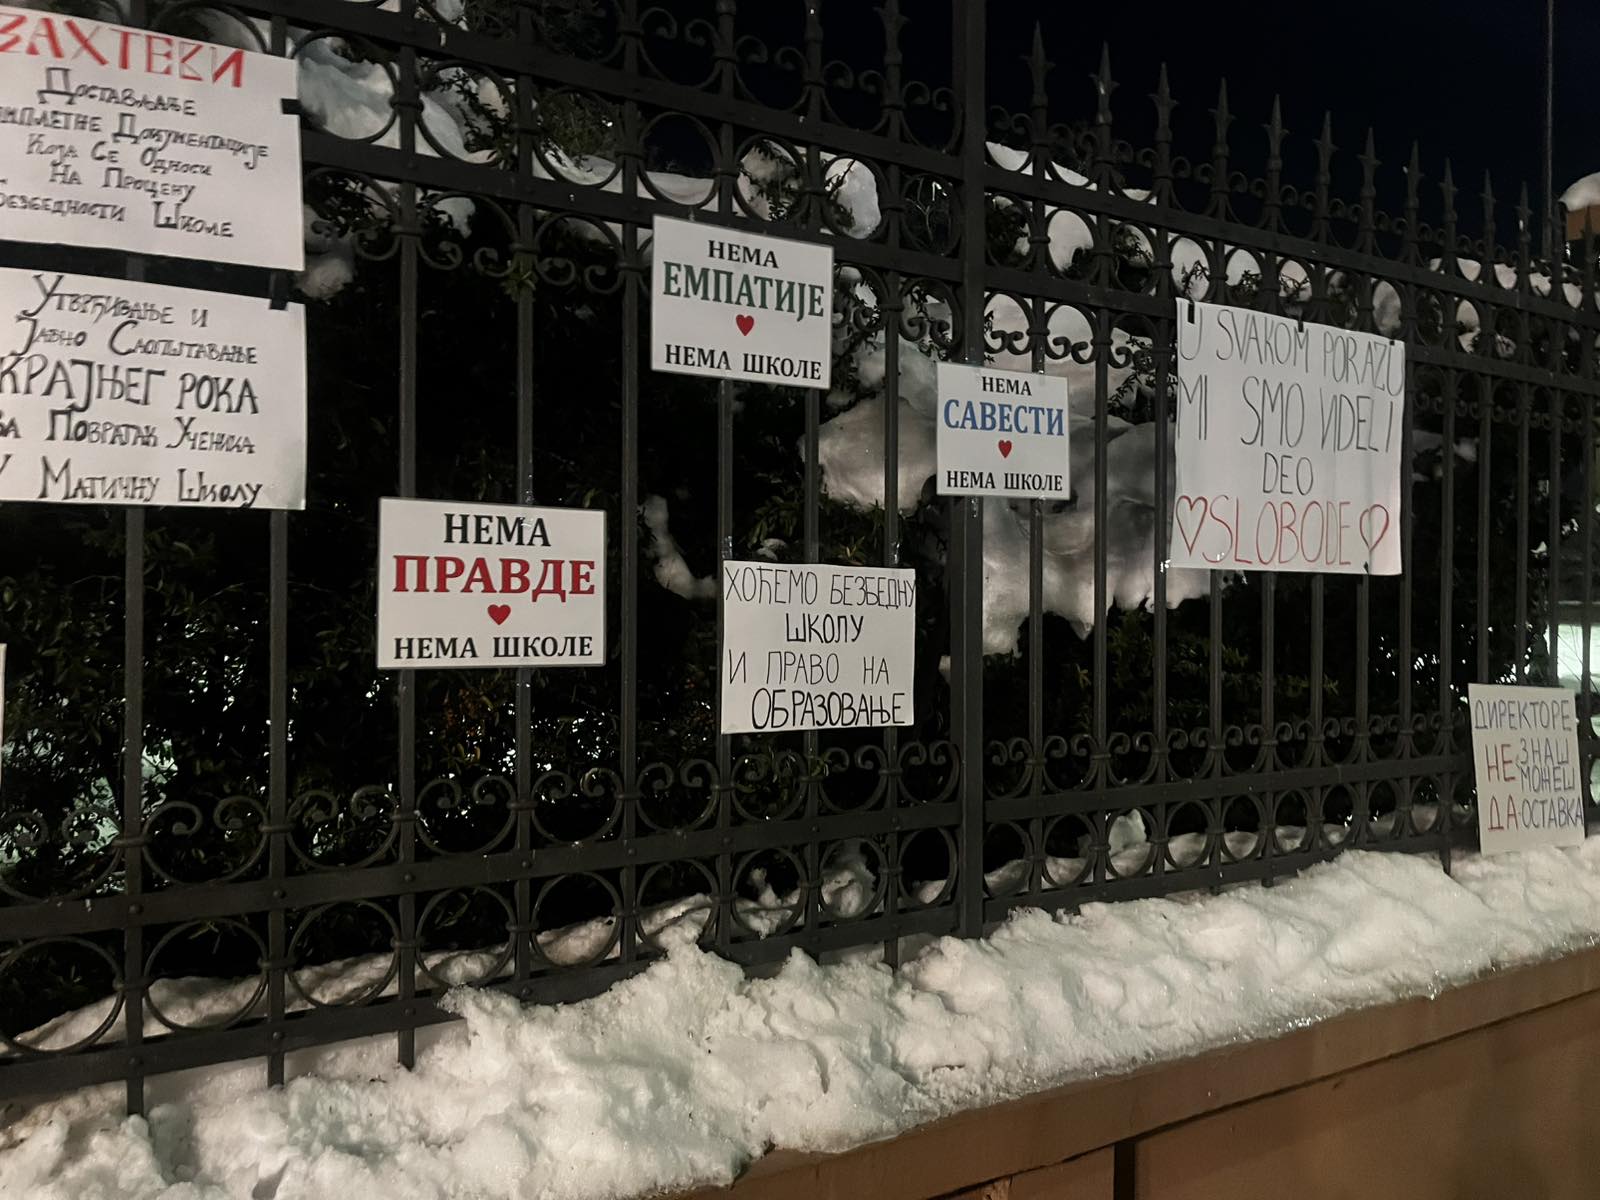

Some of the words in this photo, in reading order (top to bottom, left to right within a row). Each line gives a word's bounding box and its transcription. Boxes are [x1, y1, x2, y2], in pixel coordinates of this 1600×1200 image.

[708, 240, 779, 269] НЕМА
[663, 261, 824, 322] ЕМПАТИЈЕ
[665, 344, 731, 371] НЕМА
[743, 353, 821, 380] ШКОЛЕ
[1179, 304, 1203, 360] U
[1216, 309, 1310, 373] SVAKOM
[1323, 331, 1404, 397] PORAZU
[175, 372, 259, 414] РОКА
[982, 376, 1032, 396] НЕМА
[944, 399, 1064, 436] САВЕСТИ
[1177, 374, 1208, 440] MI
[1240, 376, 1304, 448] SMO
[1319, 387, 1393, 453] VIDELI
[946, 470, 996, 489] НЕМА
[1004, 473, 1063, 491] ШКОЛЕ
[1262, 452, 1313, 496] DEO
[444, 513, 551, 547] НЕМА
[1202, 494, 1351, 565] SLOBODE
[392, 555, 595, 603] ПРАВДЕ
[725, 566, 818, 605] ХОЋЕМО
[830, 574, 916, 610] БЕЗБЕДНУ
[786, 613, 864, 643] ШКОЛУ
[393, 637, 479, 660] НЕМА
[493, 636, 593, 658] ШКОЛЕ
[728, 649, 746, 684] И
[766, 651, 840, 685] ПРАВО
[863, 656, 889, 685] НА
[752, 688, 905, 729] ОБРАЗОВАЊЕ
[1474, 699, 1572, 732] ДИРЕКТОРЕ
[1485, 743, 1516, 782] НЕ
[1520, 738, 1570, 765] ЗНАШ
[1520, 766, 1576, 793] МОЖЕШ
